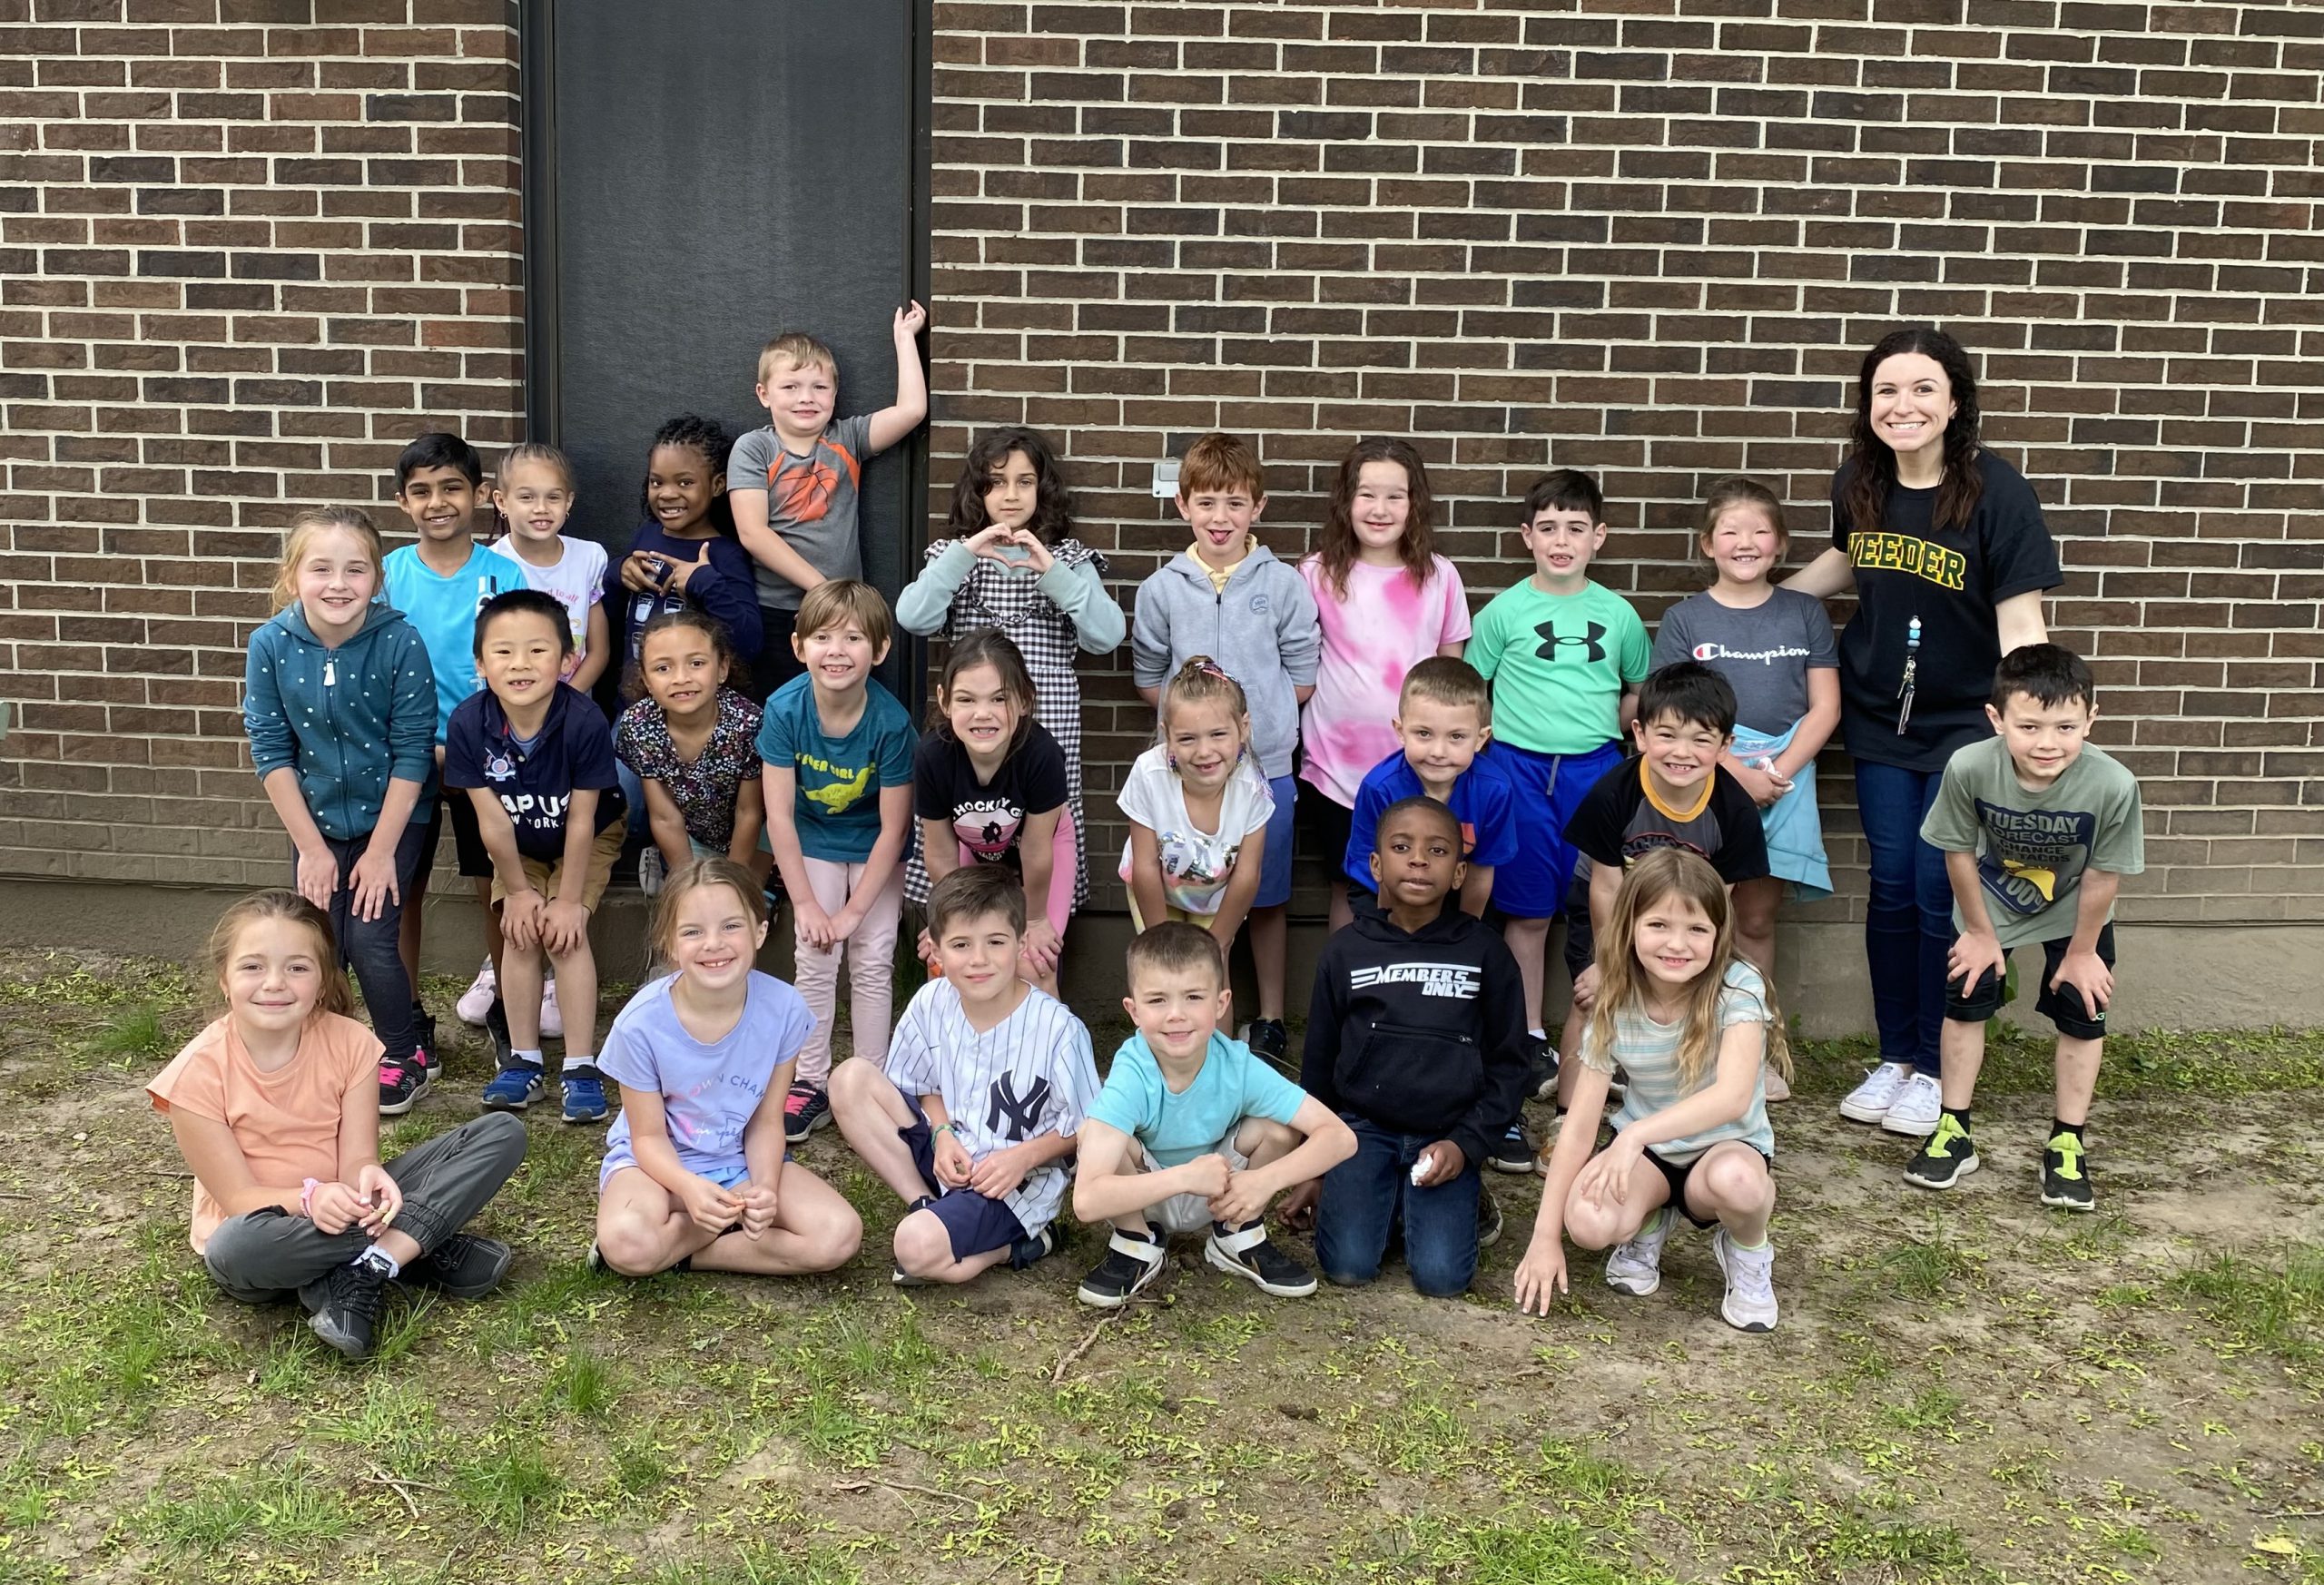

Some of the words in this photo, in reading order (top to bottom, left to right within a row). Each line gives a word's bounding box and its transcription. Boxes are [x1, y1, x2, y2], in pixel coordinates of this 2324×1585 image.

[1847, 532, 1966, 591] VEEDER
[1693, 642, 1810, 666] Champion
[1984, 807, 2081, 834] TUESDAY
[2018, 852, 2070, 862] TACOS
[1374, 967, 1469, 984] MEMBERS
[1422, 982, 1467, 999] ONLY
